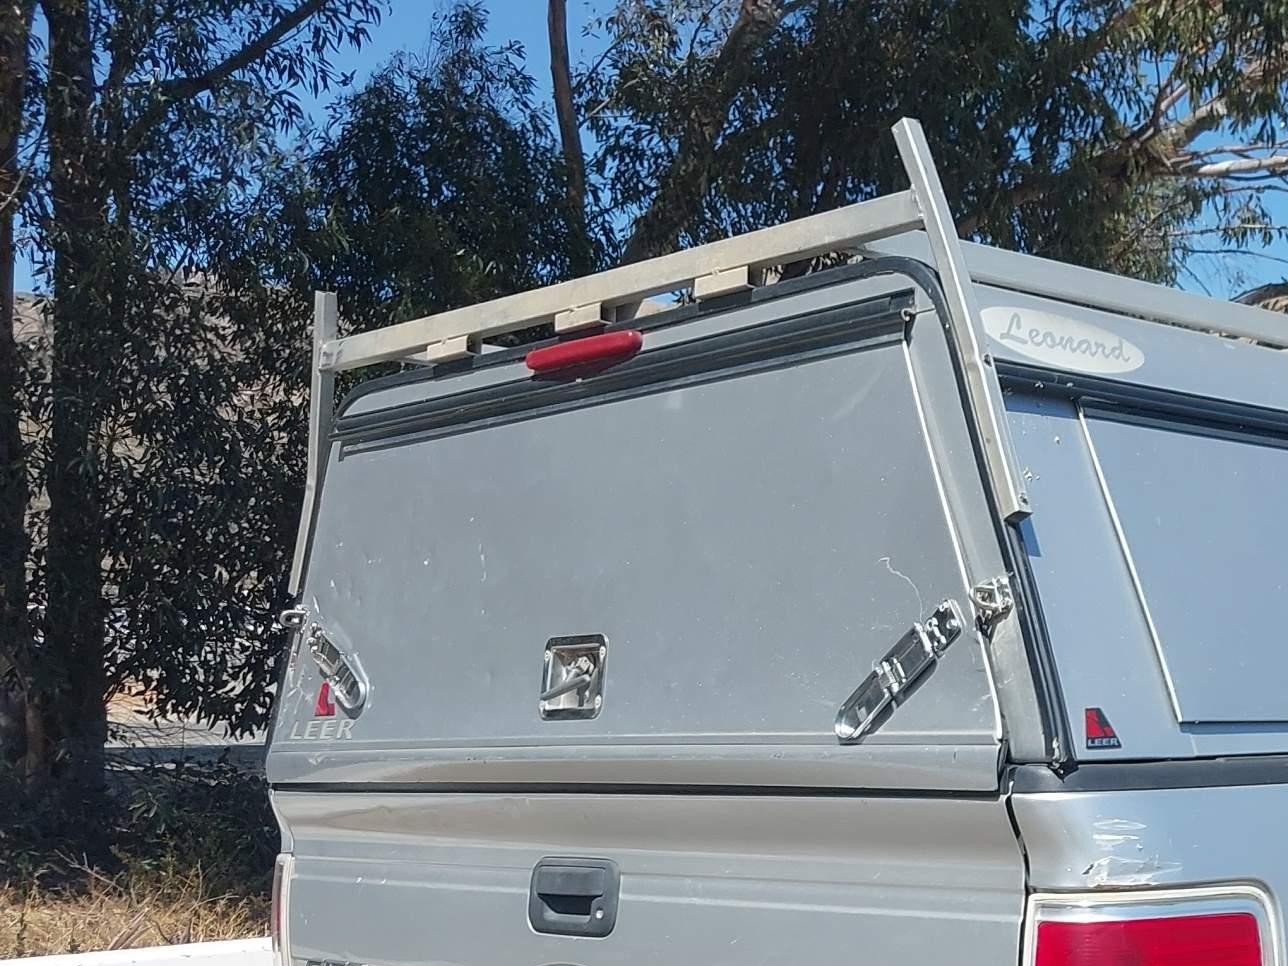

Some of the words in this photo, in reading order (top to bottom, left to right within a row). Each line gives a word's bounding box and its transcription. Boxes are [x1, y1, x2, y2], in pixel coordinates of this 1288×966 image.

[1000, 312, 1130, 362] Leonard
[290, 719, 355, 740] LEER
[1087, 738, 1118, 746] LEER
